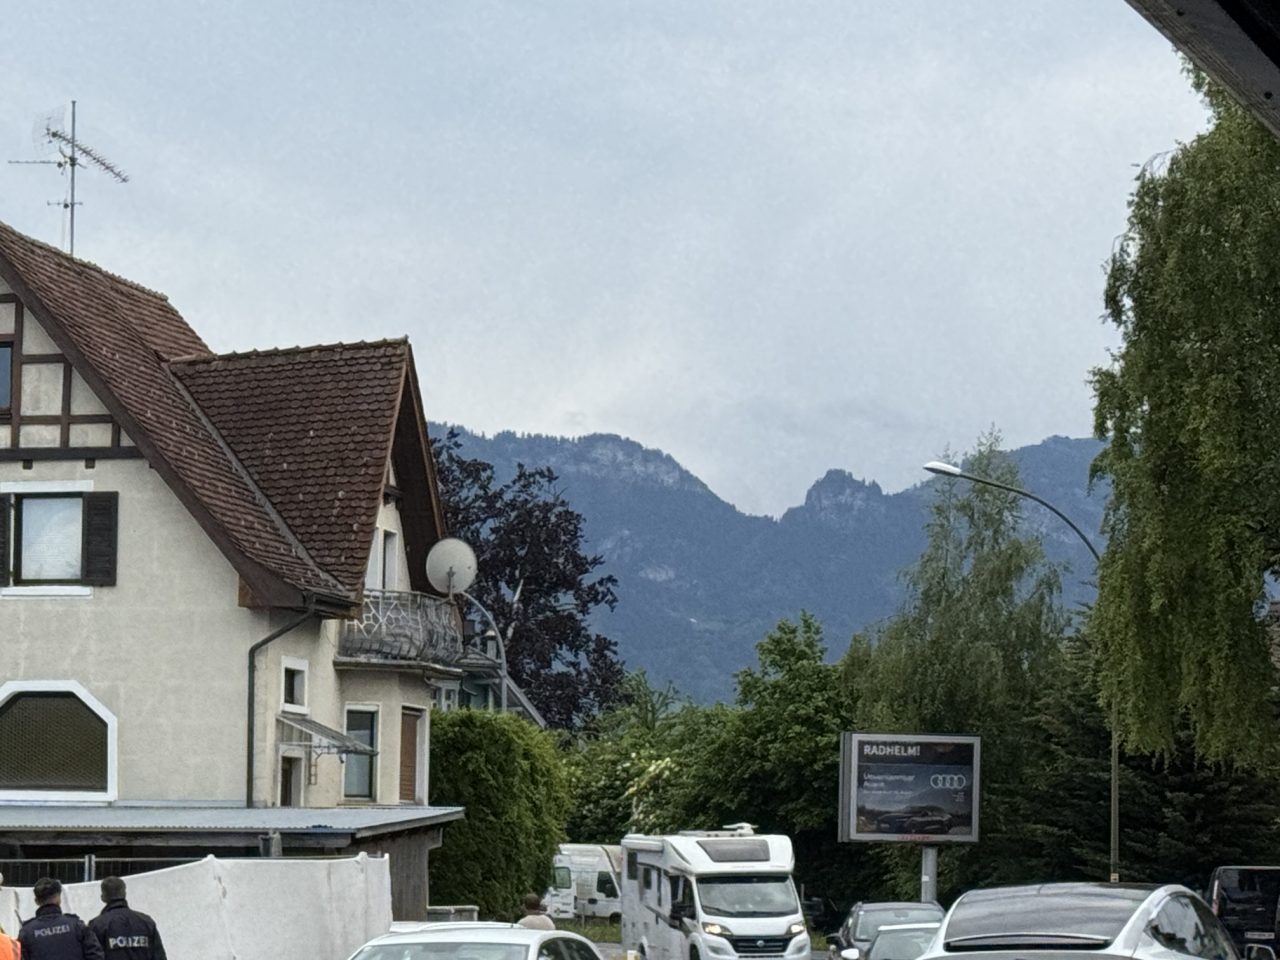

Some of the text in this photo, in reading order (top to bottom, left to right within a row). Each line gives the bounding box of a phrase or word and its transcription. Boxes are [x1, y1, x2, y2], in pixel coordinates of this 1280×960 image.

[863, 744, 921, 757] RADHELM!
[34, 924, 70, 938] POLIZEI
[108, 935, 149, 949] POLIZEI
